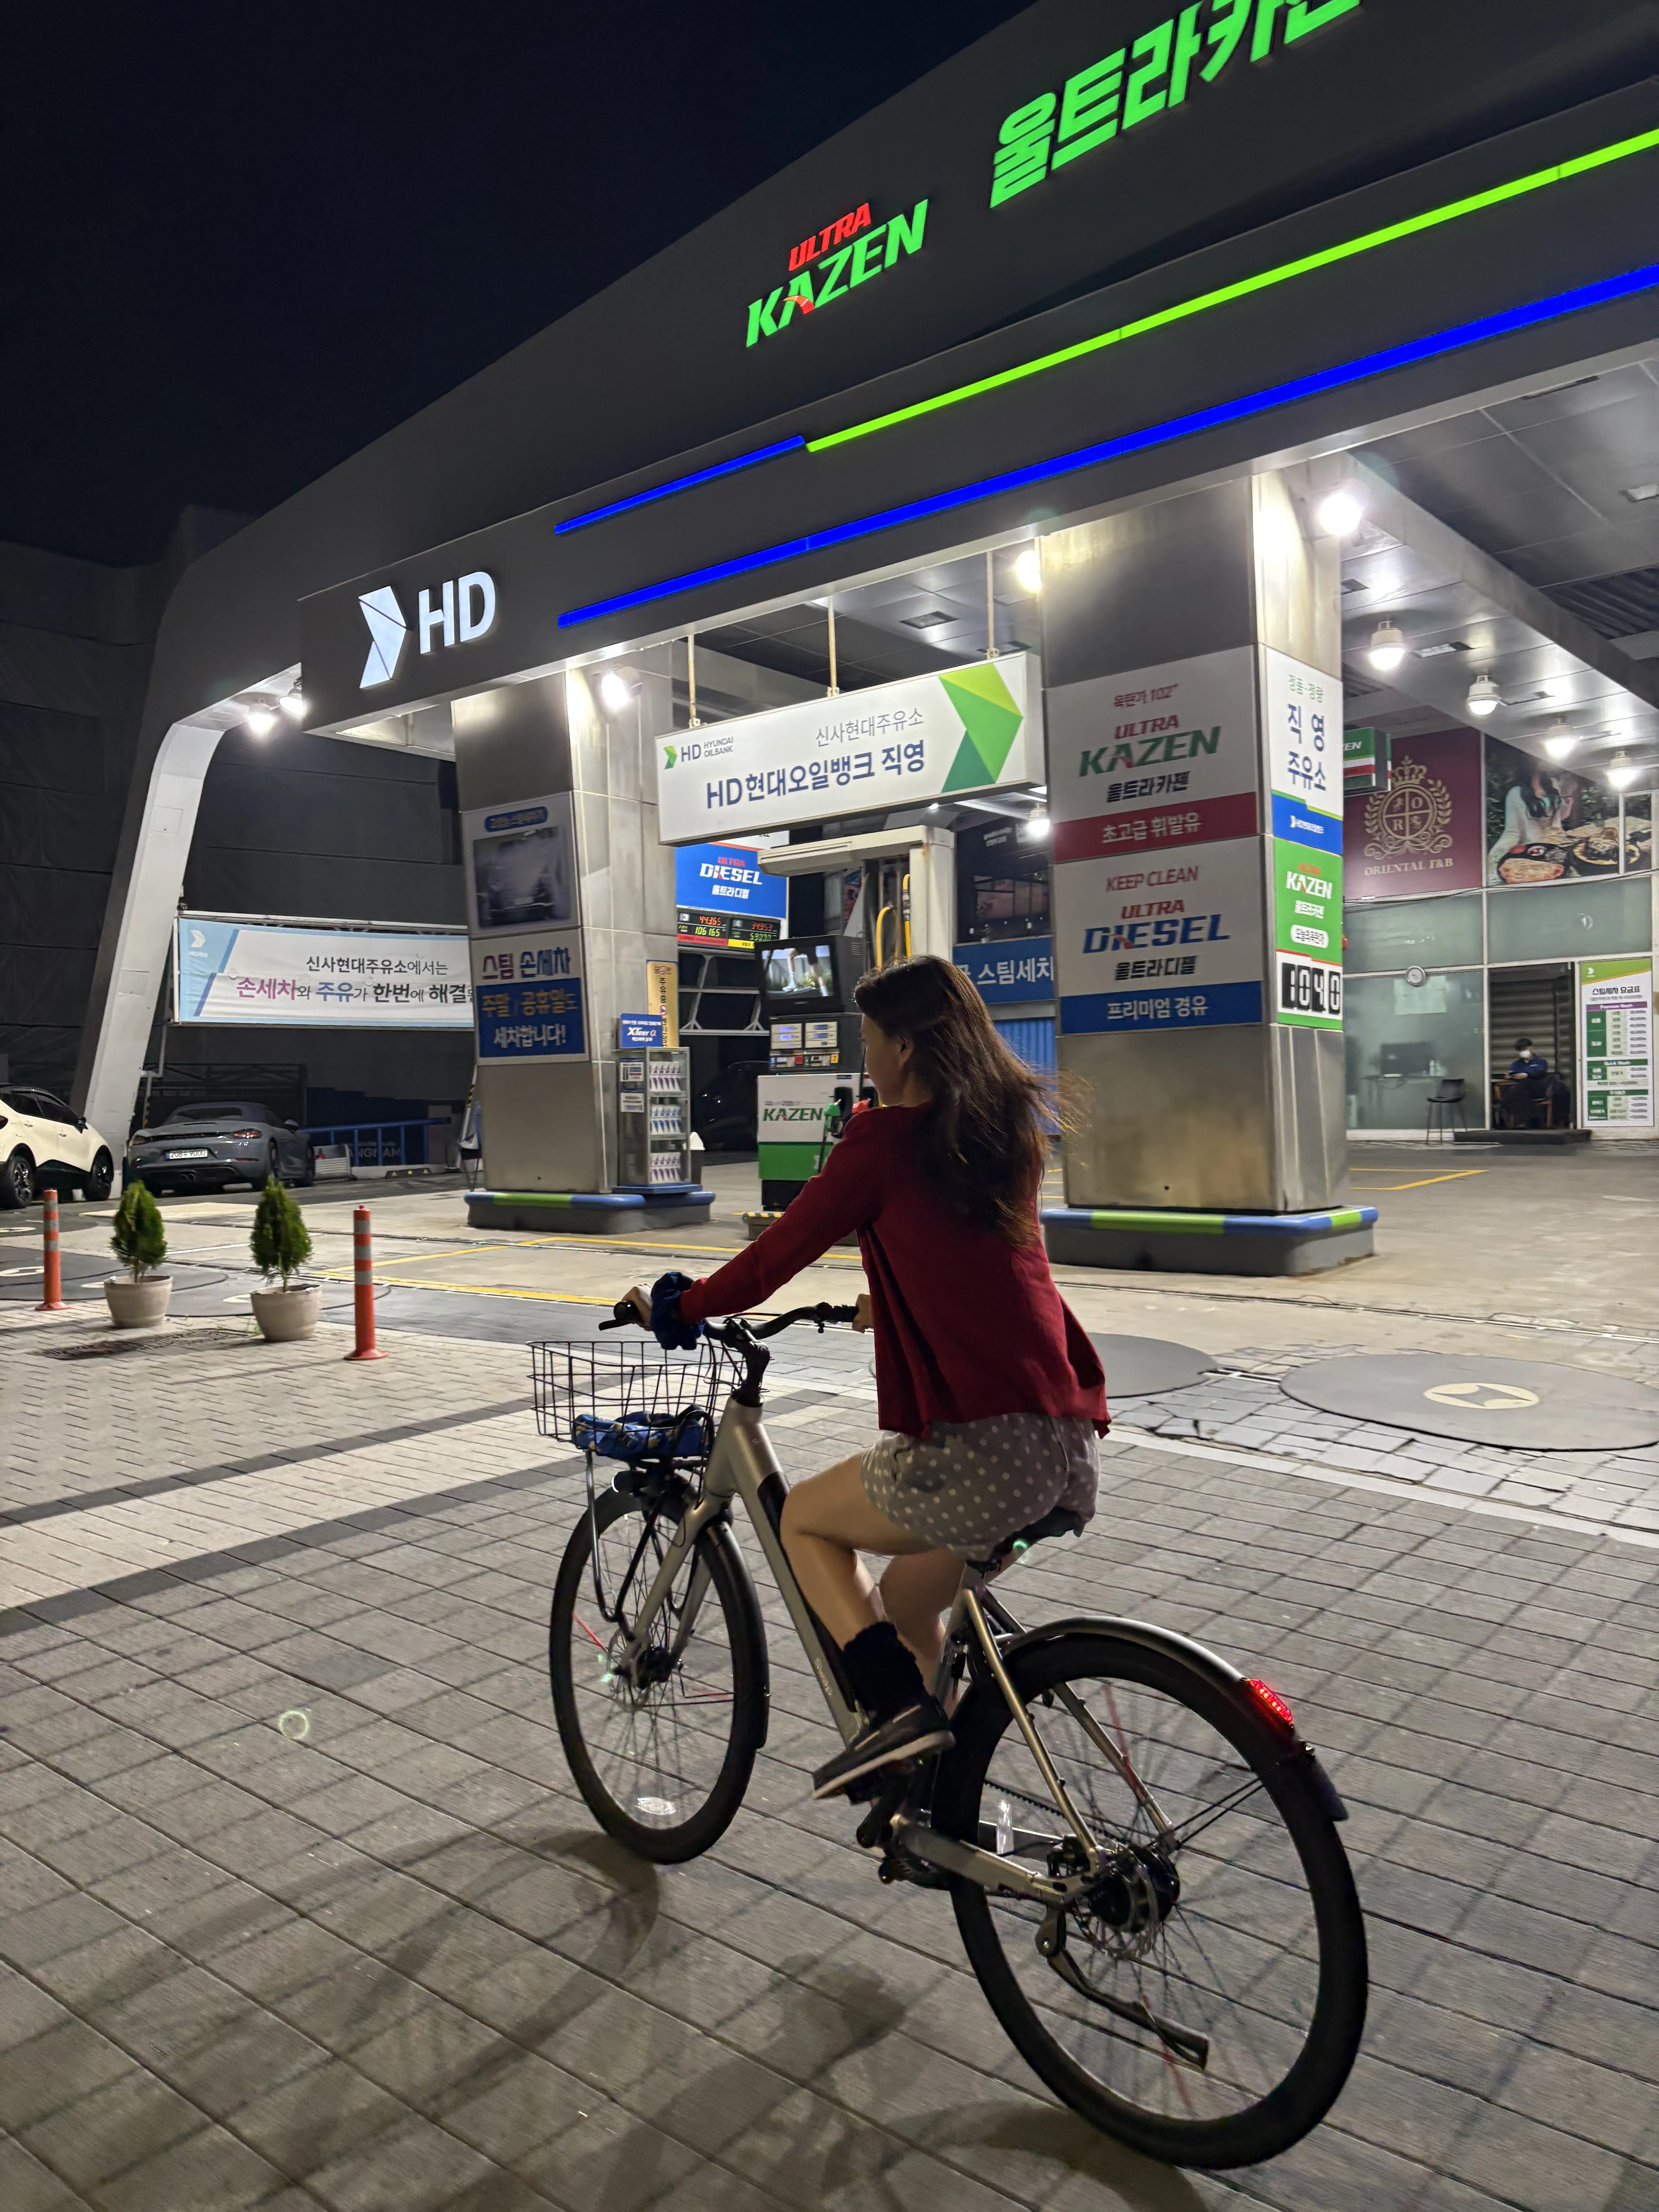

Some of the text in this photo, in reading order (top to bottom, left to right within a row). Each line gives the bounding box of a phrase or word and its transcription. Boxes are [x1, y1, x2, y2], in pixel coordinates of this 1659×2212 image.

[788, 202, 871, 271] ULTRA
[746, 198, 929, 348] KAZEN
[419, 572, 496, 654] HD
[815, 707, 924, 747] 신사현대주유소
[1114, 714, 1179, 739] ULTRA
[681, 744, 701, 762] HD
[704, 736, 733, 749] HYUNDAI
[704, 745, 733, 757] OILBANK
[1079, 726, 1222, 777] KAZEN
[706, 739, 925, 809] HD현대오일뱅크 직영
[1287, 751, 1326, 792] 주유소
[1106, 771, 1191, 803] 울트라카젠
[1102, 812, 1202, 843] 초고급 휘발유
[699, 863, 763, 885] DIESEL
[1106, 866, 1199, 891] KEEP CLEAN
[1365, 858, 1453, 875] ORIENTAL F&B
[1286, 871, 1333, 899] KAZEN
[1121, 900, 1185, 919] ULTRA
[1082, 914, 1230, 954] DIESEL
[306, 956, 448, 976] 신사현대주유소에서는
[483, 947, 571, 980] 스팀 손세차
[1115, 956, 1197, 981] 울트라디젤
[236, 977, 311, 1001] 손세차와
[315, 981, 369, 1003] 주유가
[373, 982, 424, 1004] 한번에
[1107, 995, 1208, 1020] 프리미엄 경유
[493, 1024, 567, 1048] 세차합니다!
[763, 1108, 824, 1121] KAZEN
